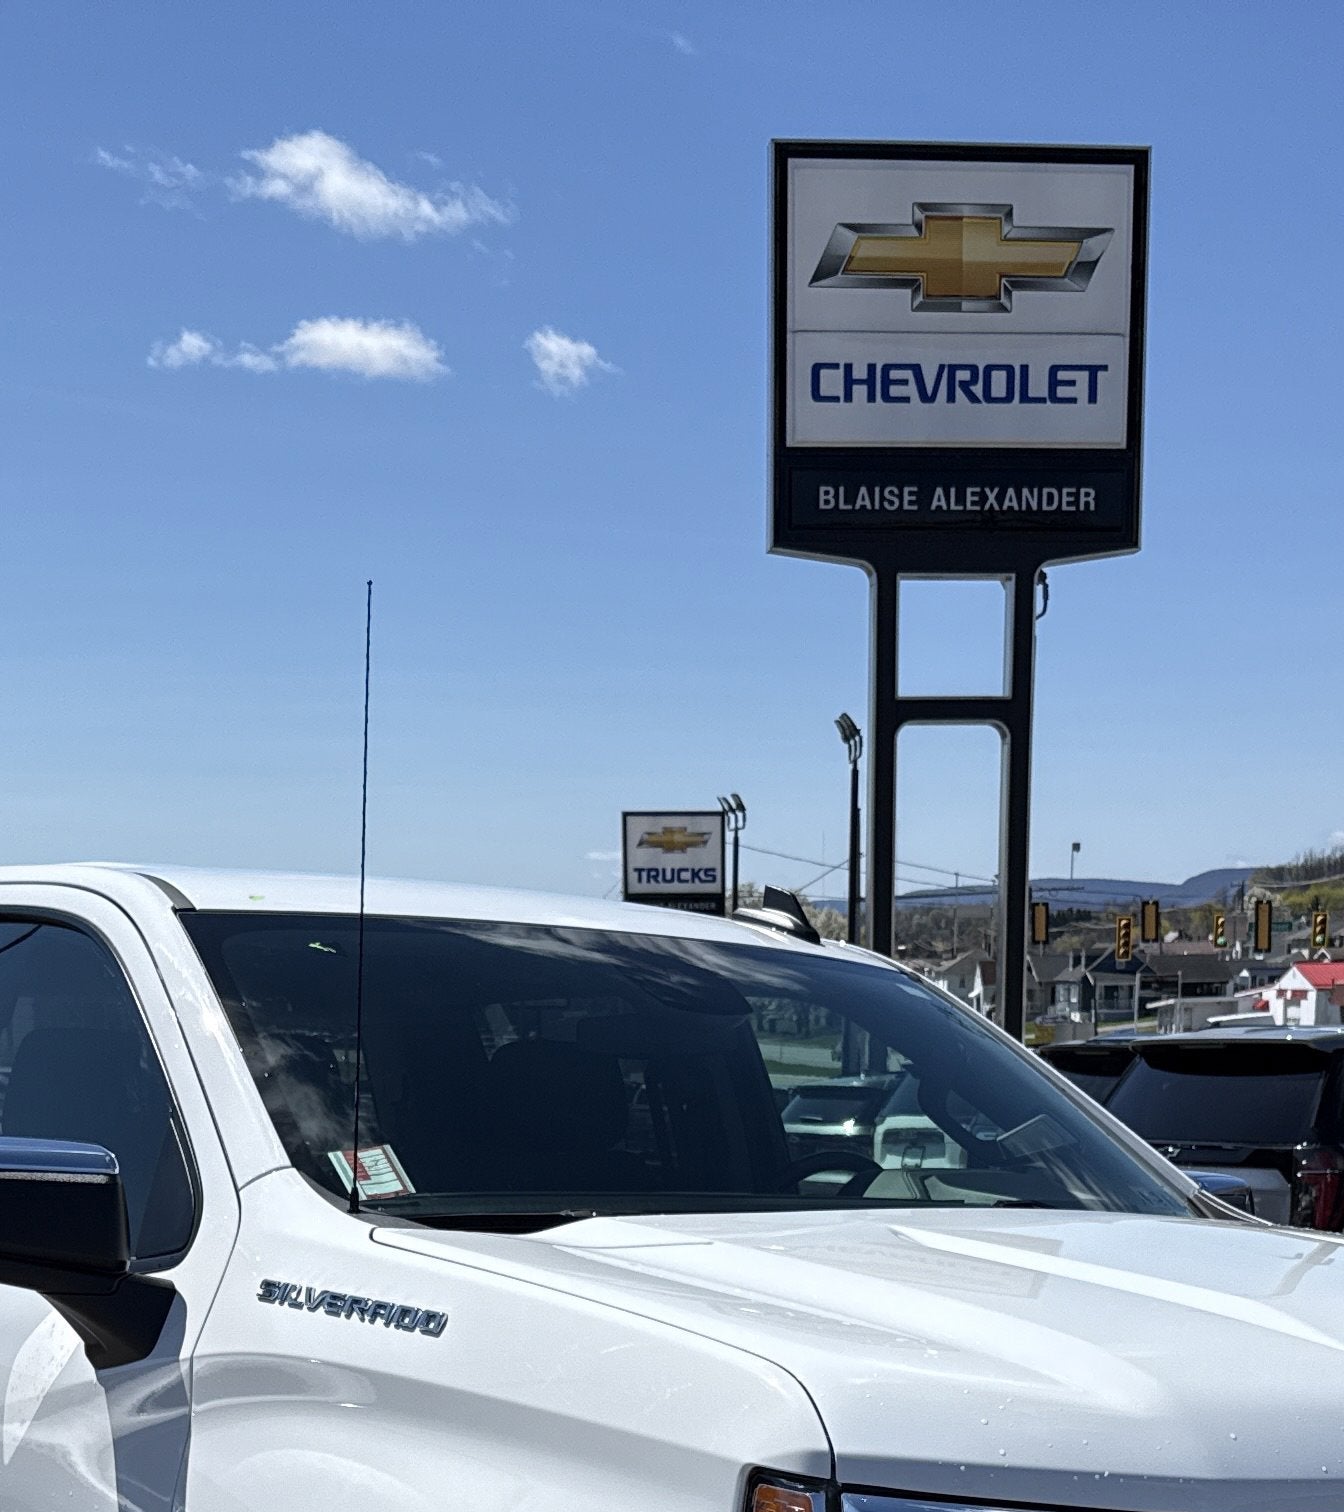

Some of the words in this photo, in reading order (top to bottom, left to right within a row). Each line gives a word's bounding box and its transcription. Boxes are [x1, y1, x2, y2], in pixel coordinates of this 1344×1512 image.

[811, 363, 1108, 404] CHEVROLET
[818, 486, 918, 511] BLAISE
[930, 487, 1096, 511] ALEXANDER
[633, 868, 717, 884] TRUCKS
[257, 1279, 448, 1338] SILVERADO
